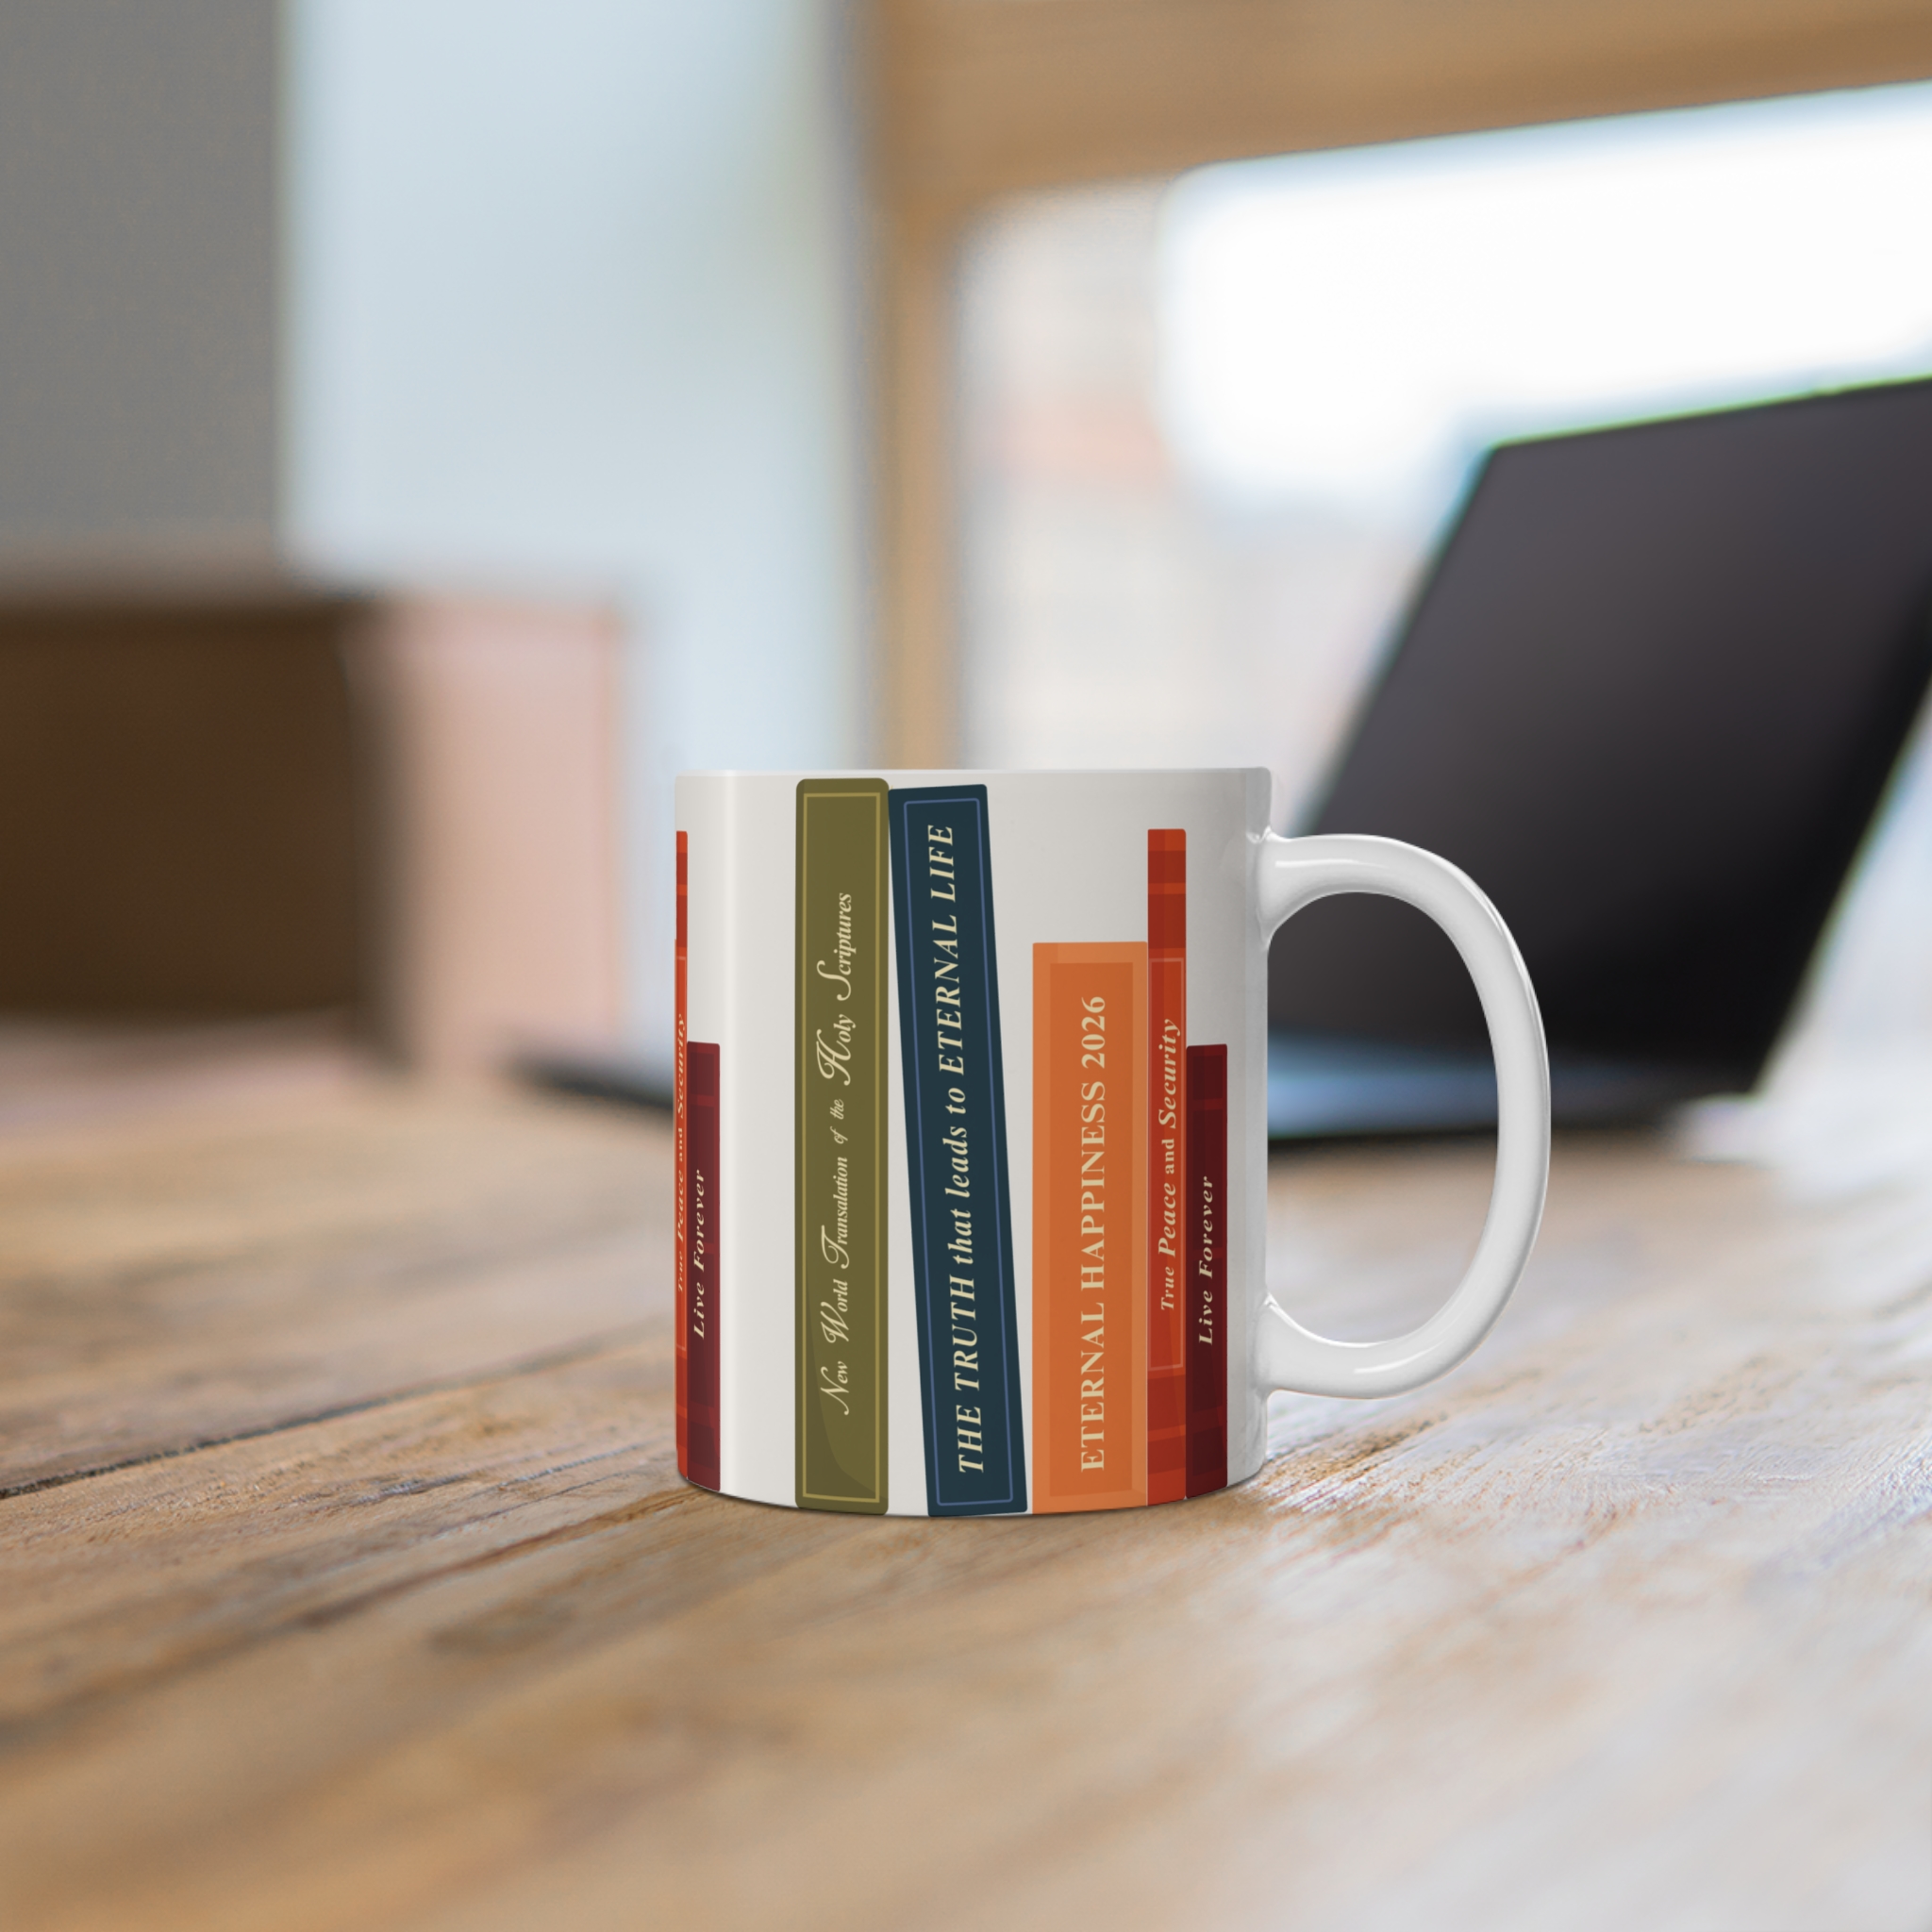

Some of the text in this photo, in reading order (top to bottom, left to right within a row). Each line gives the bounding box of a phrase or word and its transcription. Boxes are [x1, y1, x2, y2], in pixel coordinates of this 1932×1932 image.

[693, 1170, 705, 1339] Live Forever
[816, 892, 857, 1415] New World Transalation of the Holy Scriptures
[927, 824, 984, 1474] THE TRUTH that leads to ETERNAL LIFE
[1080, 996, 1106, 1473] ETERNAL HAPPINESS 2026
[1158, 1019, 1181, 1310] True Peace and Security
[1198, 1175, 1213, 1345] Live Forever
